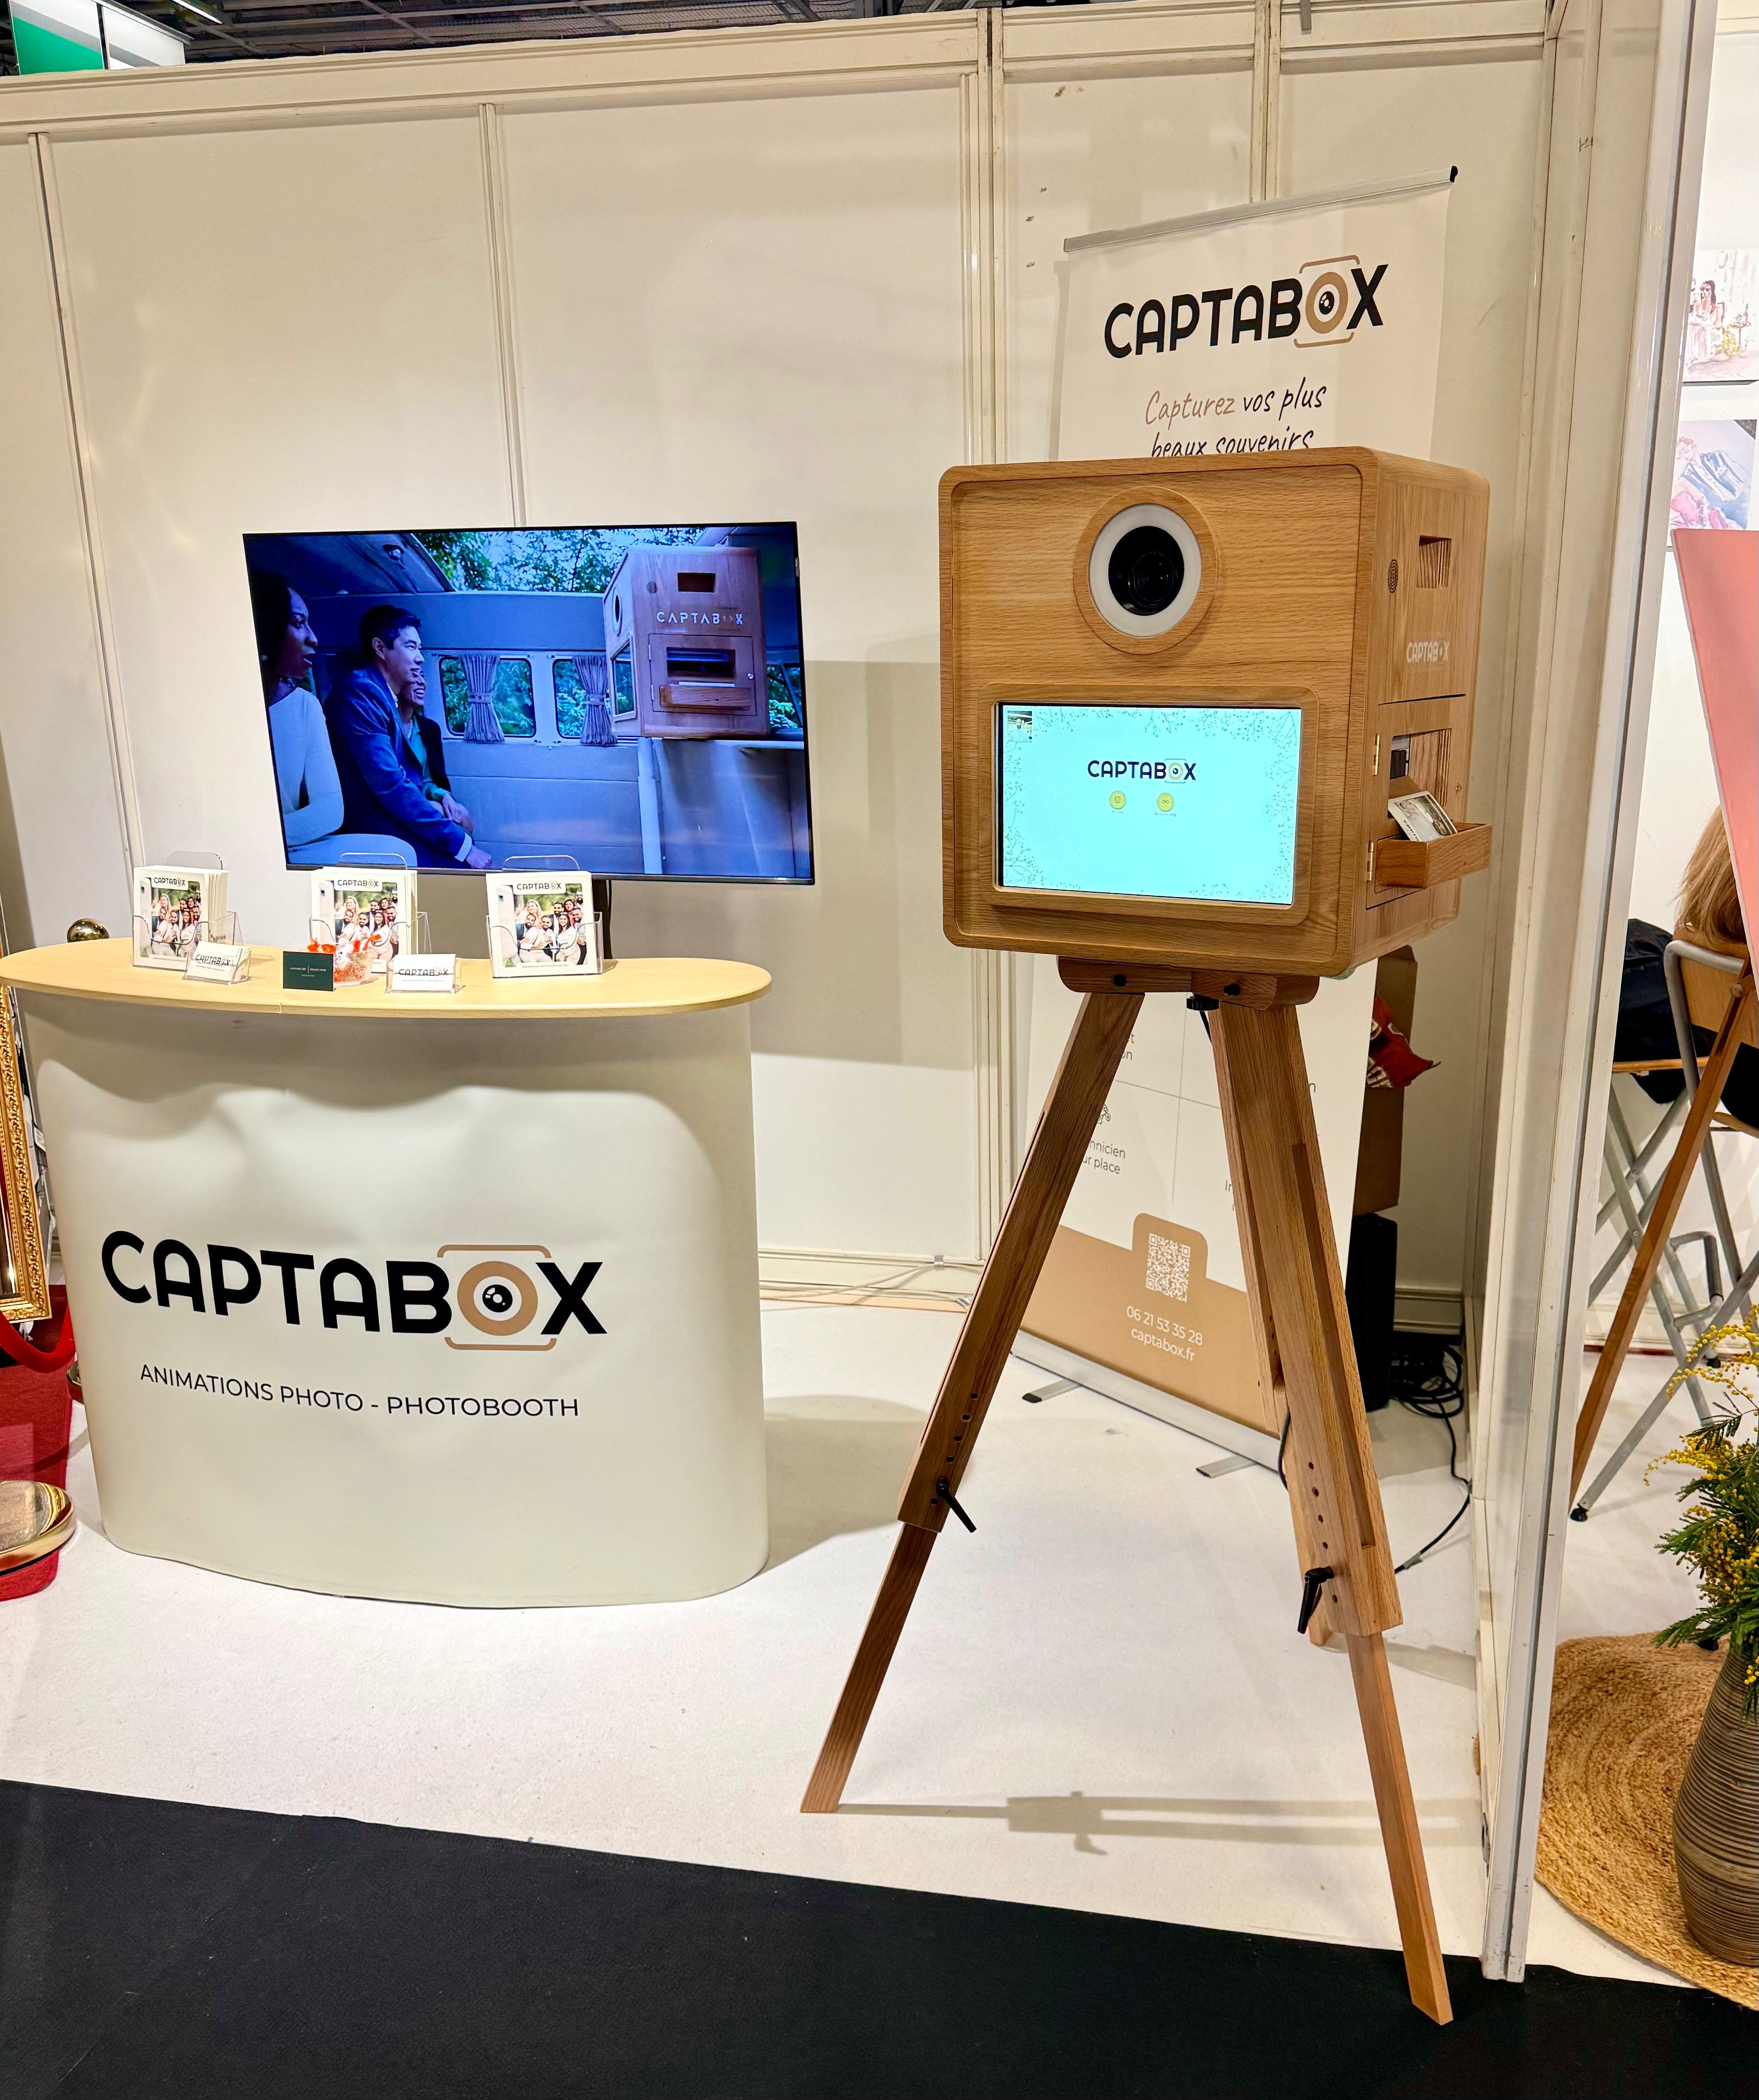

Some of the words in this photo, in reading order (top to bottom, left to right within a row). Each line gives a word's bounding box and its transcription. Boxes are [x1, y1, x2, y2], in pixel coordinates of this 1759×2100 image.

[1104, 264, 1389, 359] CAPTABOX
[1145, 390, 1235, 430] Capturez
[1243, 390, 1275, 412] vos
[1279, 376, 1327, 421] plus
[1152, 431, 1207, 458] beaux
[1215, 425, 1314, 454] souvenirs
[1087, 760, 1197, 781] CAPTABOX
[517, 882, 562, 890] CAPTABOX
[1094, 1157, 1120, 1174] place
[101, 1230, 608, 1336] CAPTABOX
[1127, 1306, 1141, 1321] 06
[1143, 1312, 1154, 1326] 21
[1156, 1317, 1170, 1332] 53
[1171, 1323, 1186, 1339] 35
[1188, 1330, 1203, 1345] 28
[1131, 1328, 1195, 1361] captabox.fr
[140, 1364, 274, 1402] ANIMATIONS
[280, 1385, 364, 1412] PHOTO
[387, 1396, 579, 1418] PHOTOBOOTH
